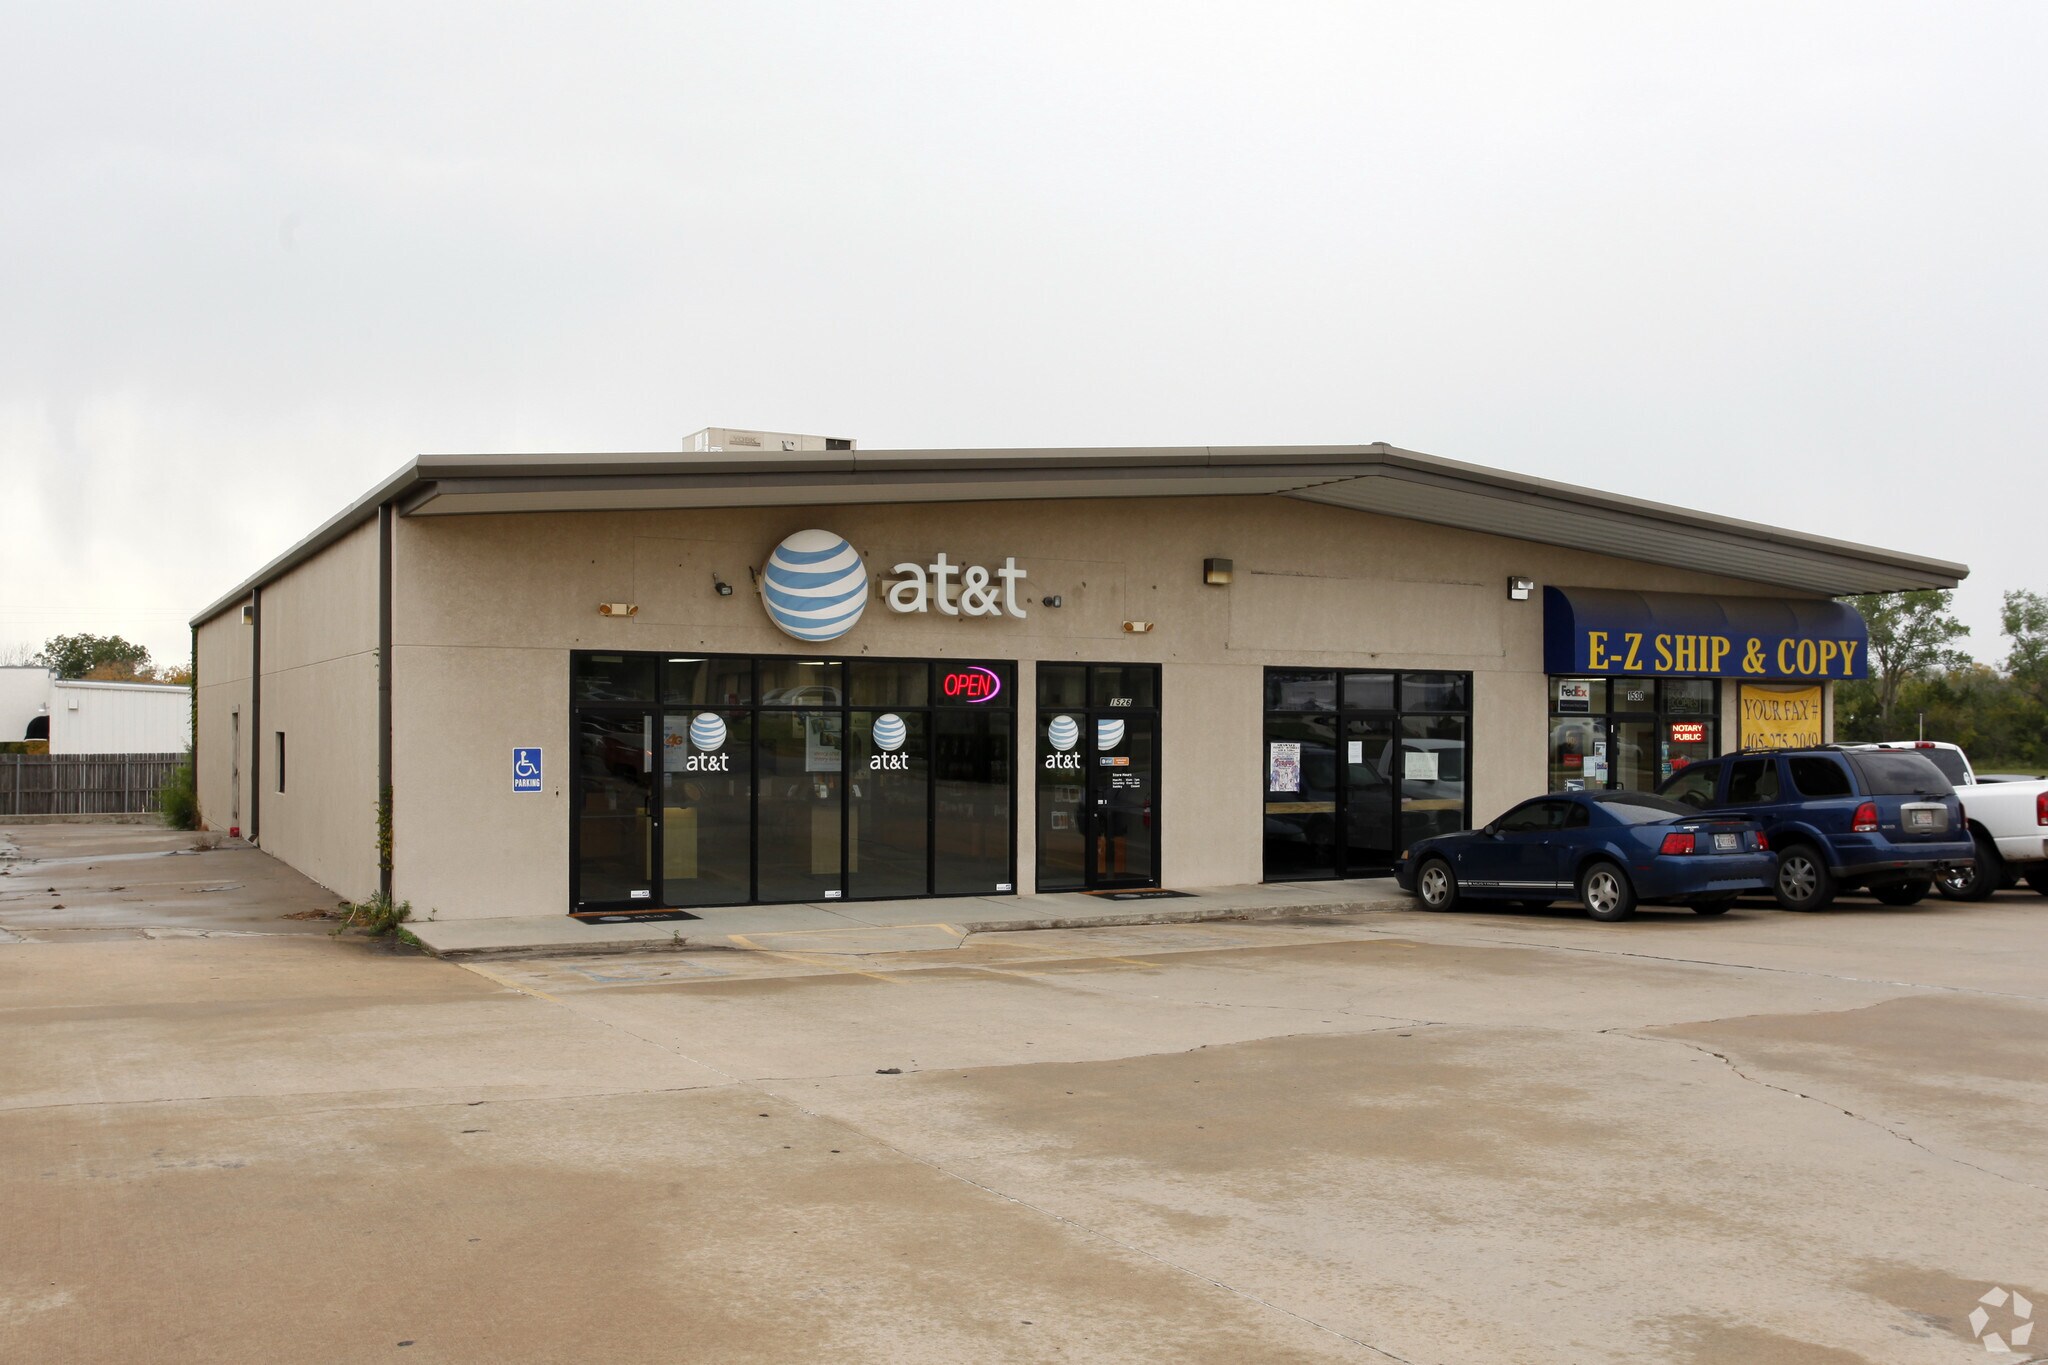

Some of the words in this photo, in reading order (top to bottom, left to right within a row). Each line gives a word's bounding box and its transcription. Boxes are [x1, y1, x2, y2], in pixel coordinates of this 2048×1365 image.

[887, 552, 1028, 619] at&t
[1587, 630, 1644, 671] E-Z
[1654, 633, 1731, 673] SHIP
[1741, 637, 1767, 674] &
[1776, 638, 1859, 676] COPY
[944, 673, 992, 697] OPEN
[1561, 684, 1588, 698] FedEx
[1109, 697, 1133, 708] 1526
[1627, 690, 1644, 701] 1530
[1743, 699, 1782, 721] YOUR
[1784, 700, 1810, 721] FAX
[1811, 699, 1819, 720] #
[1672, 724, 1703, 732] NOTARY
[1673, 733, 1702, 741] PUBLIC
[686, 752, 730, 772] at&t
[869, 751, 909, 770] at&t
[1045, 751, 1081, 769] at&t
[514, 778, 541, 787] PARKING
